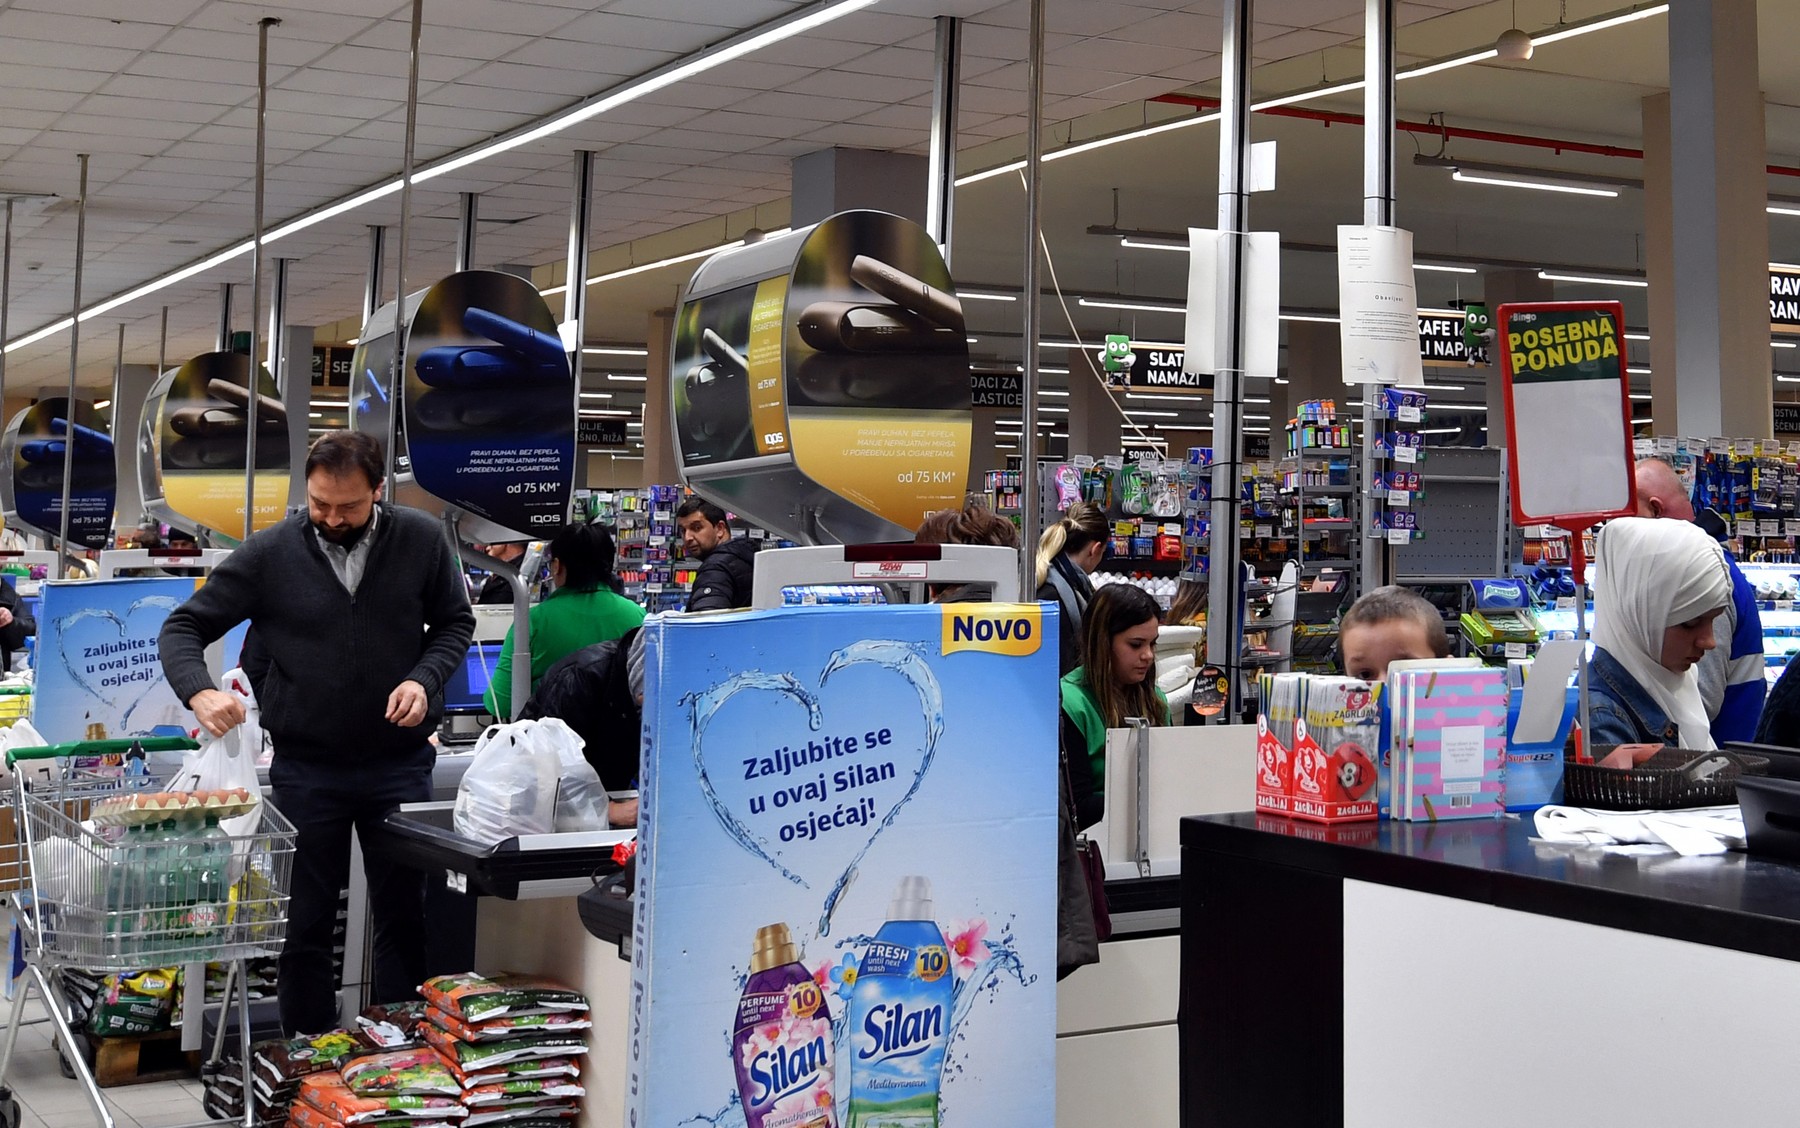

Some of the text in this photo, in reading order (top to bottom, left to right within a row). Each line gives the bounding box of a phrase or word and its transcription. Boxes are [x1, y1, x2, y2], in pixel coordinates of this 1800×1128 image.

[1513, 313, 1537, 323] Bingo
[1508, 317, 1614, 352] POSEBNA
[1433, 340, 1483, 357] NAPII
[1510, 336, 1619, 375] PONUDA
[1149, 351, 1184, 367] SLAT
[970, 376, 1018, 389] DACI ZA
[1147, 370, 1200, 385] NAMAZI
[971, 392, 1023, 405] LASTICE
[578, 432, 623, 443] ŠNO, RIŽA
[764, 432, 784, 445] IQOS
[897, 471, 913, 483] od
[916, 471, 930, 483] 75
[507, 483, 521, 493] od
[523, 482, 537, 493] 75
[530, 514, 561, 524] IQOS
[953, 615, 1031, 642] Novo
[83, 637, 158, 658] Zaljubite s
[86, 664, 95, 674] u
[98, 655, 128, 672] ovaj
[101, 668, 154, 687] osjećaj!
[742, 728, 892, 781] Zaljubite se
[749, 761, 896, 815] u ovaj Silan
[779, 797, 876, 842] osjećaj!
[868, 944, 910, 961] FRESH
[867, 957, 901, 967] until next
[867, 965, 886, 973] wash
[920, 952, 943, 971] 10
[741, 995, 785, 1010] PERFUME
[792, 989, 816, 1010] 10
[741, 1004, 776, 1017] until next
[742, 1014, 761, 1024] wash
[859, 1003, 942, 1060] Silan
[751, 1036, 827, 1107] Silan
[866, 1078, 927, 1090] Mediterranean
